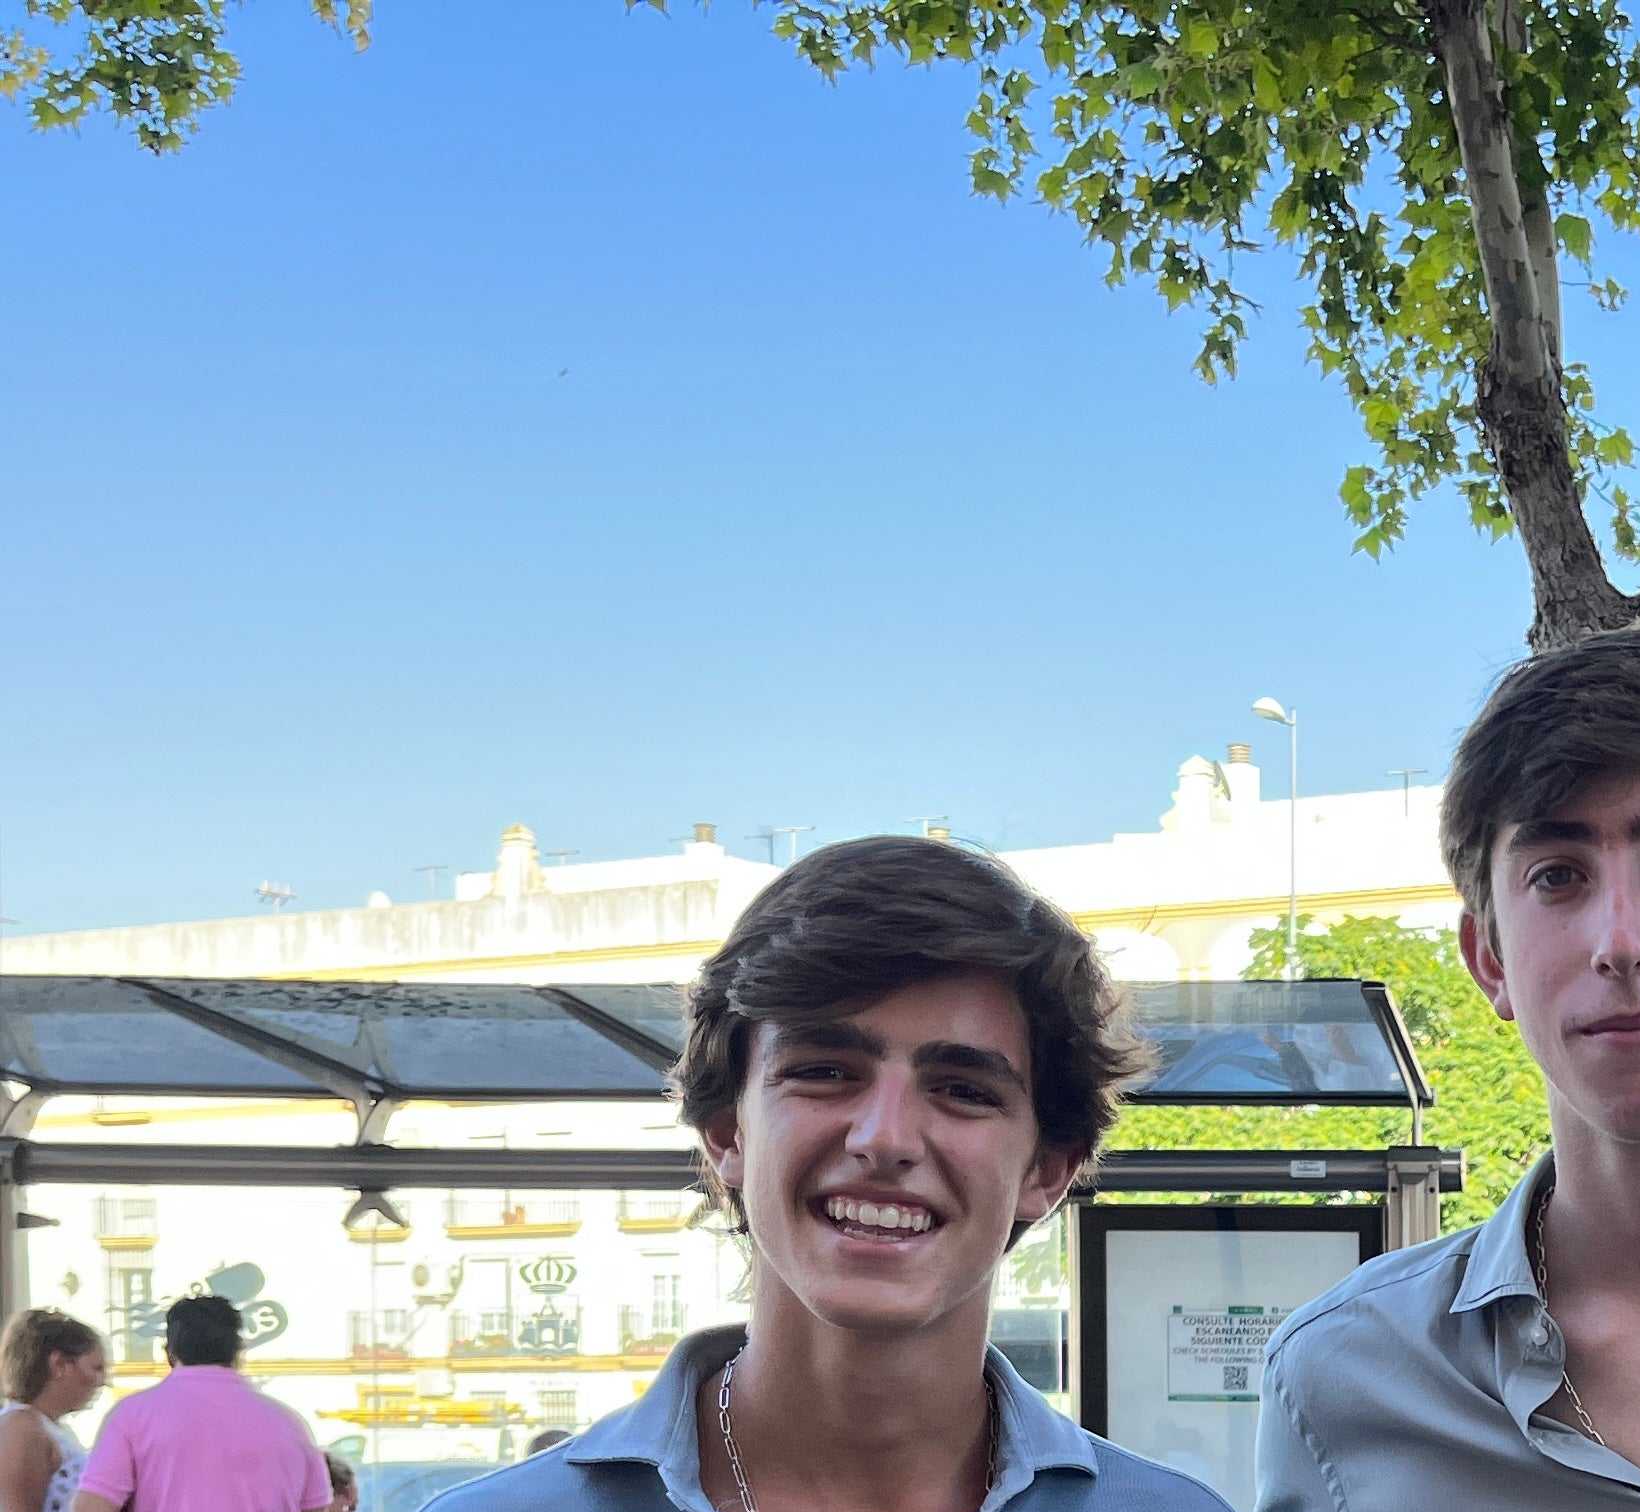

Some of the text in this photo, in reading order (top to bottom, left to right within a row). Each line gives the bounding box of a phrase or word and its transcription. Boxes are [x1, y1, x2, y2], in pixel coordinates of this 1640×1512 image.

[1183, 1316, 1285, 1326] CONSULTE HORARIO
[1196, 1327, 1266, 1336] ESCANEANDO
[1191, 1336, 1244, 1346] SIGUIENTE
[1173, 1347, 1200, 1355] CHECK
[1201, 1347, 1246, 1355] SCHEDULES
[1248, 1347, 1257, 1355] BY
[1194, 1356, 1209, 1364] THE
[1211, 1356, 1257, 1364] FOLLOWING
